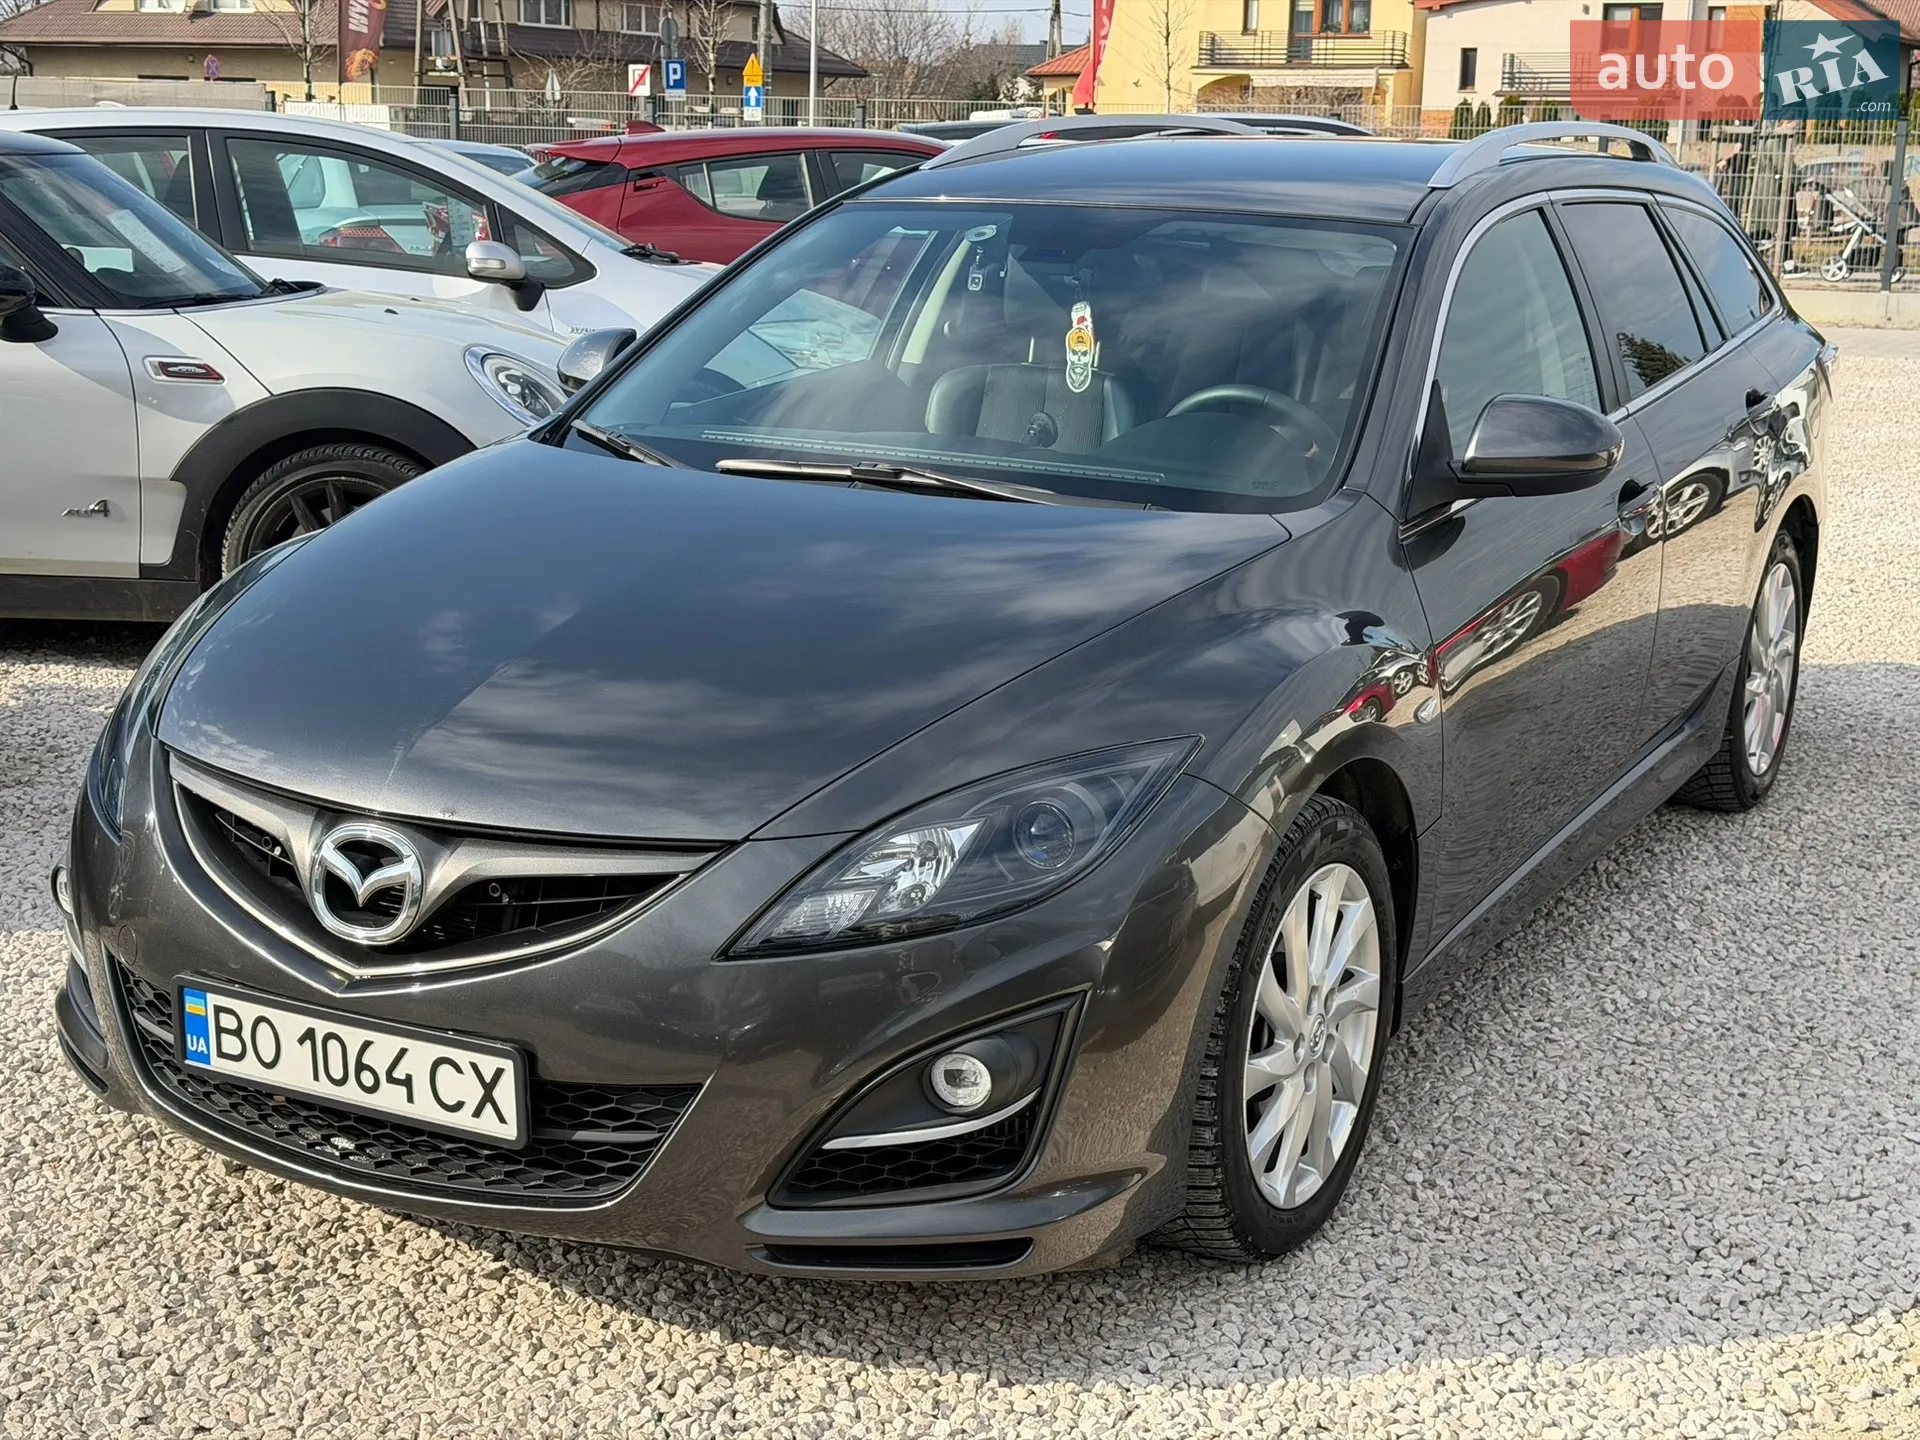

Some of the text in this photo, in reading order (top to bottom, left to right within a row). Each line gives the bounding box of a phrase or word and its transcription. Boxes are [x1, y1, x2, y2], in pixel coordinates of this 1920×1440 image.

[668, 62, 682, 87] P
[186, 1032, 208, 1055] UA
[213, 1003, 508, 1125] BO 1064 CX
